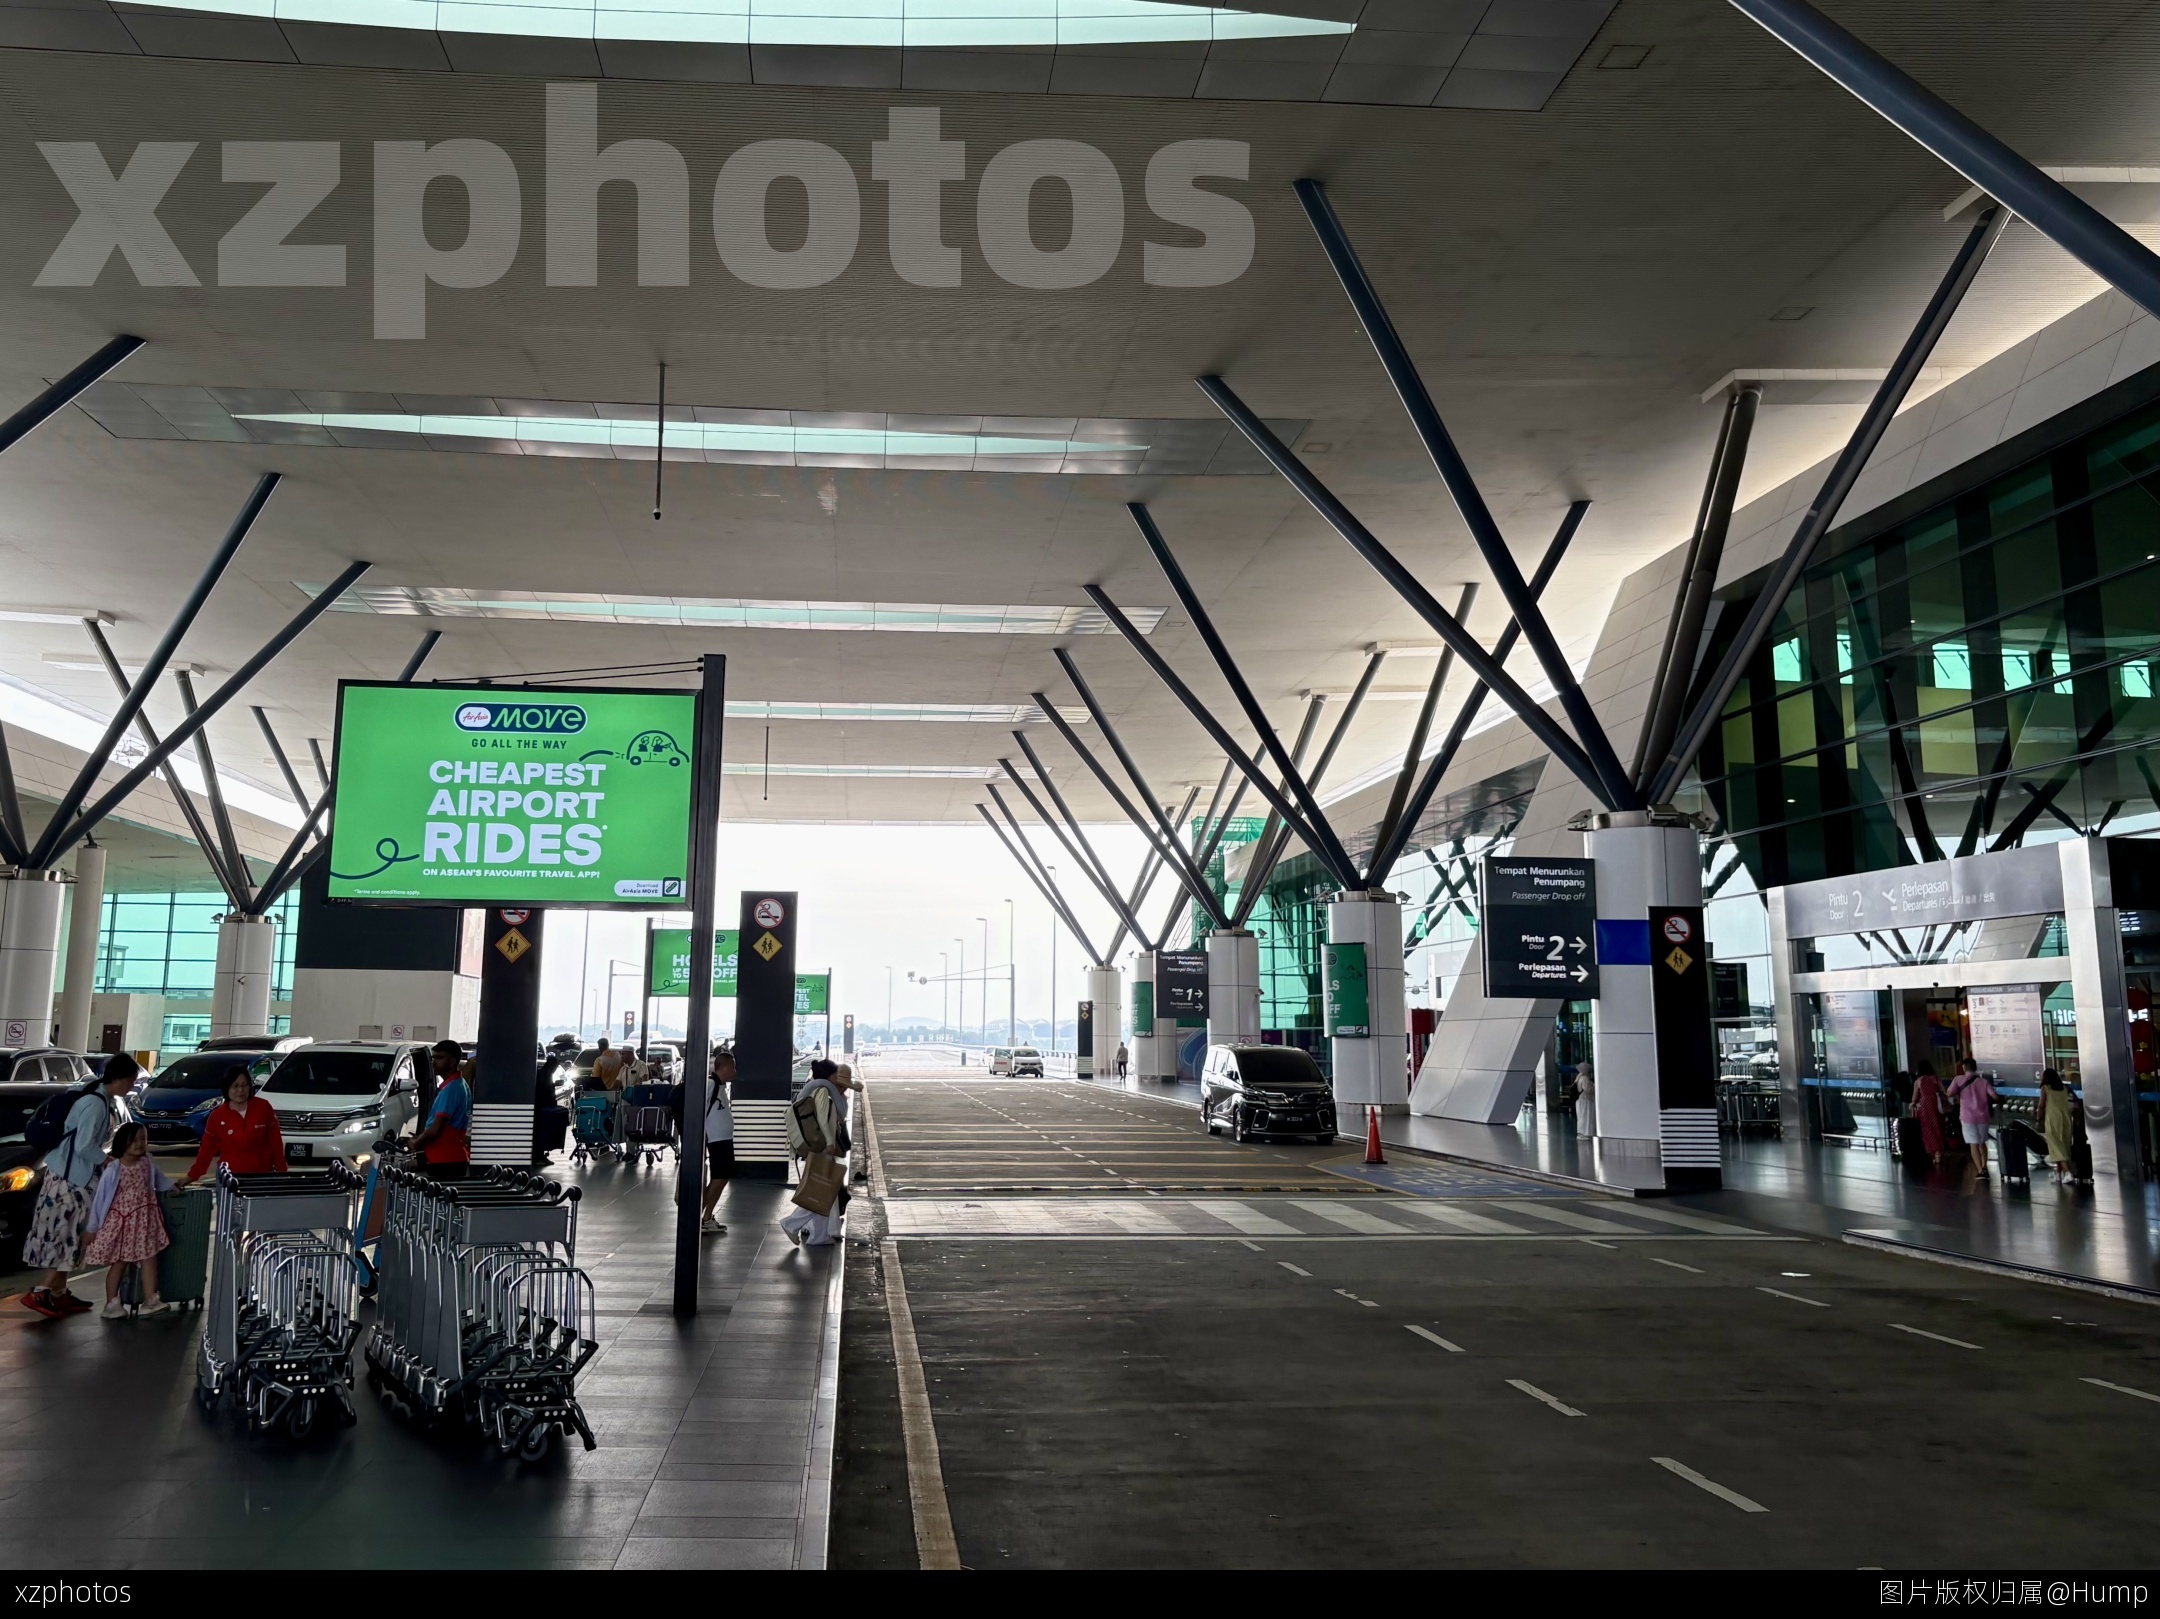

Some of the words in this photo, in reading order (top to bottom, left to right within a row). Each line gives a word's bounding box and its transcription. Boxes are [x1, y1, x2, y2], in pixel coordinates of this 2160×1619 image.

[472, 738, 487, 748] GO
[491, 739, 512, 748] ALL
[517, 740, 538, 749] THE
[543, 740, 567, 749] WAY
[429, 760, 607, 786] CHEAPEST
[427, 789, 605, 818] AIRPORT
[423, 868, 437, 876] ON
[440, 869, 482, 877] ASEAN'S
[484, 869, 537, 878] FAVOURITE
[539, 870, 575, 878] TRAVEL
[577, 871, 600, 879] APP!
[1494, 866, 1527, 876] Tempat
[1529, 867, 1585, 876] Menurunkan
[1533, 877, 1585, 888] Penumpang
[1901, 880, 1949, 898] Perlepasan
[1511, 891, 1551, 901] Passenger
[1552, 892, 1571, 901] Drop
[1573, 892, 1586, 900] off
[1828, 893, 1849, 907] Pintu
[1852, 890, 1864, 917] 2
[1902, 899, 1938, 913] Departures
[1830, 909, 1844, 921] Door
[1521, 934, 1545, 943] Pintu
[1546, 935, 1565, 961] 2
[1518, 963, 1566, 972] Perlepasan
[1186, 988, 1193, 1001] 1
